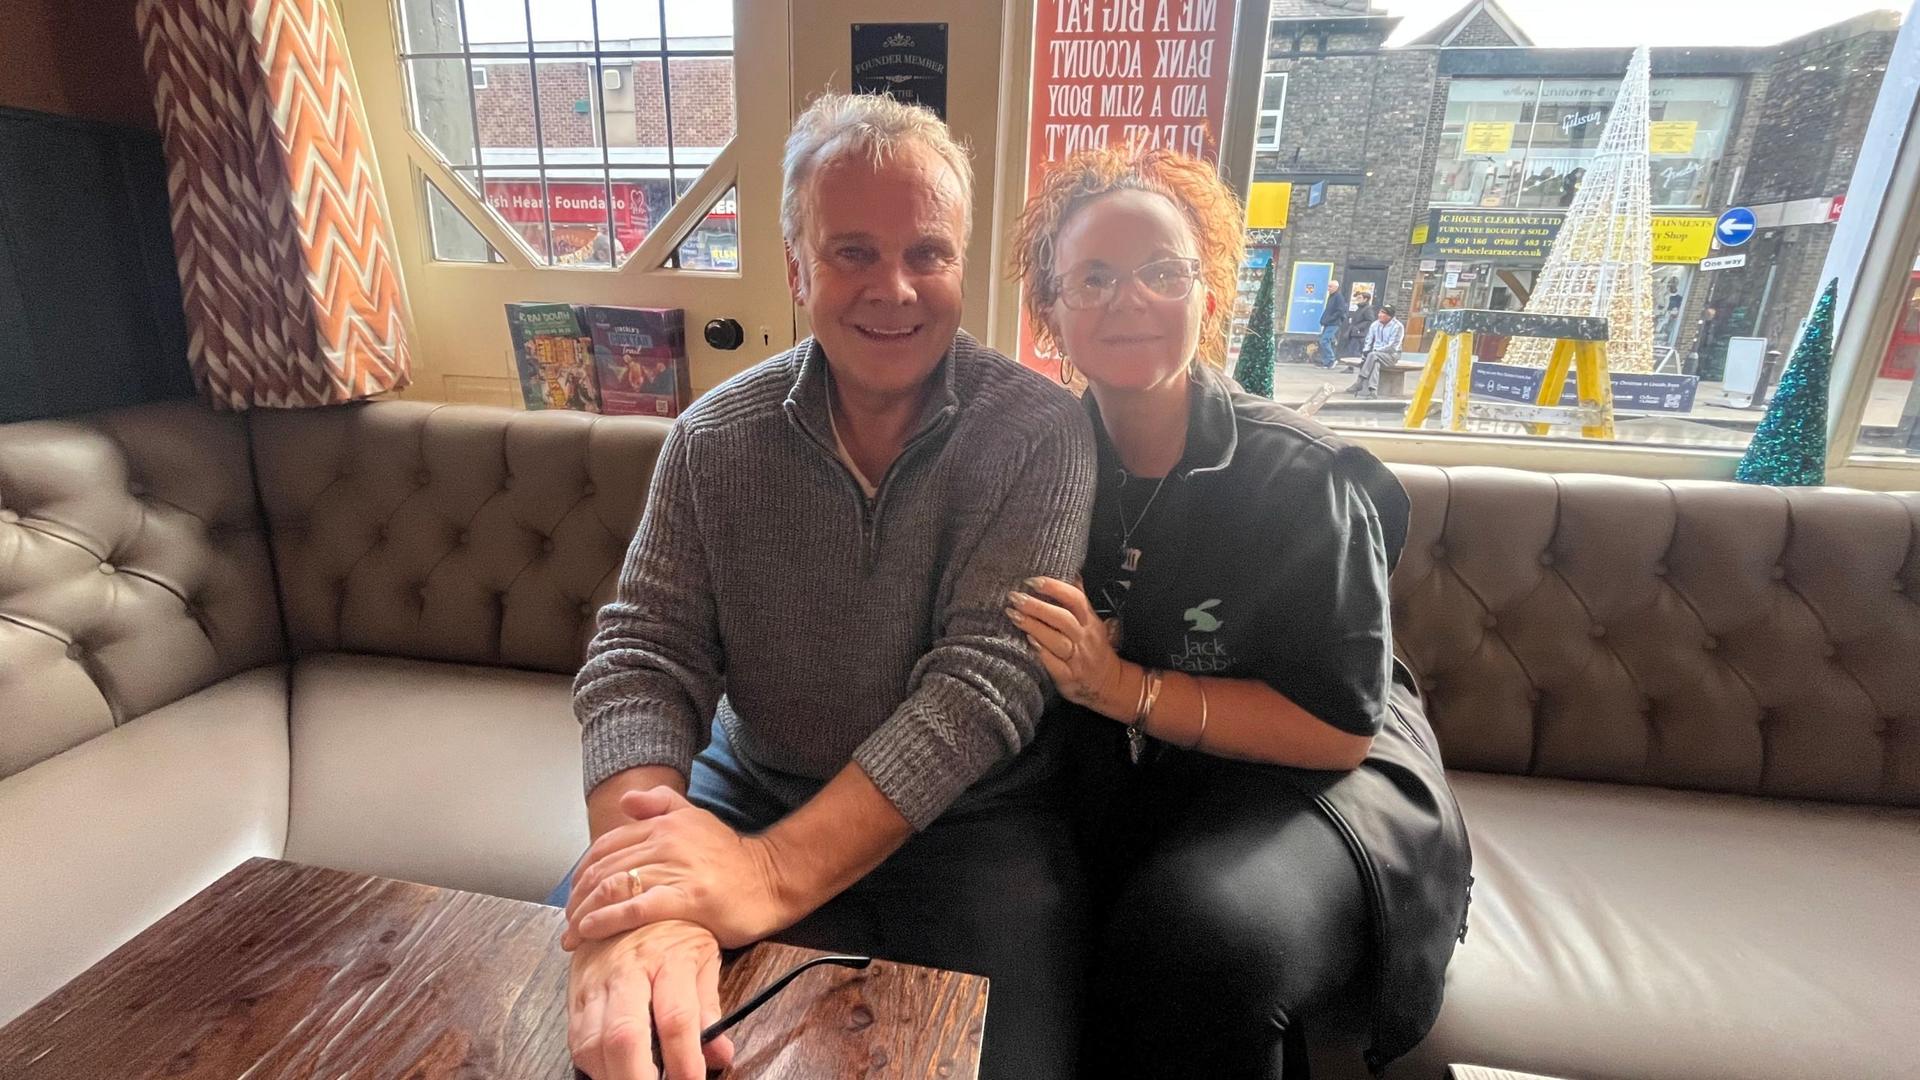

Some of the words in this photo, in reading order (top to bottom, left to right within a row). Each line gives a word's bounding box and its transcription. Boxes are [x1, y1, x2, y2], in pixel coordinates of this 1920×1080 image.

[855, 54, 902, 74] FOUNDER
[904, 54, 945, 74] MEMBER
[1562, 111, 1602, 136] Gibson
[1452, 214, 1481, 224] HOUSE
[1485, 215, 1539, 225] CLEARANCE
[1541, 216, 1561, 225] LTD
[1440, 226, 1483, 234] FURNITURE
[1485, 227, 1518, 235] BOUGHT
[1527, 228, 1549, 236] SOLD
[1663, 230, 1688, 242] Shop
[1440, 246, 1542, 257] www.abcclearance.co.uk
[1703, 259, 1722, 268] One
[1724, 257, 1742, 267] way
[1183, 634, 1227, 660] Jack
